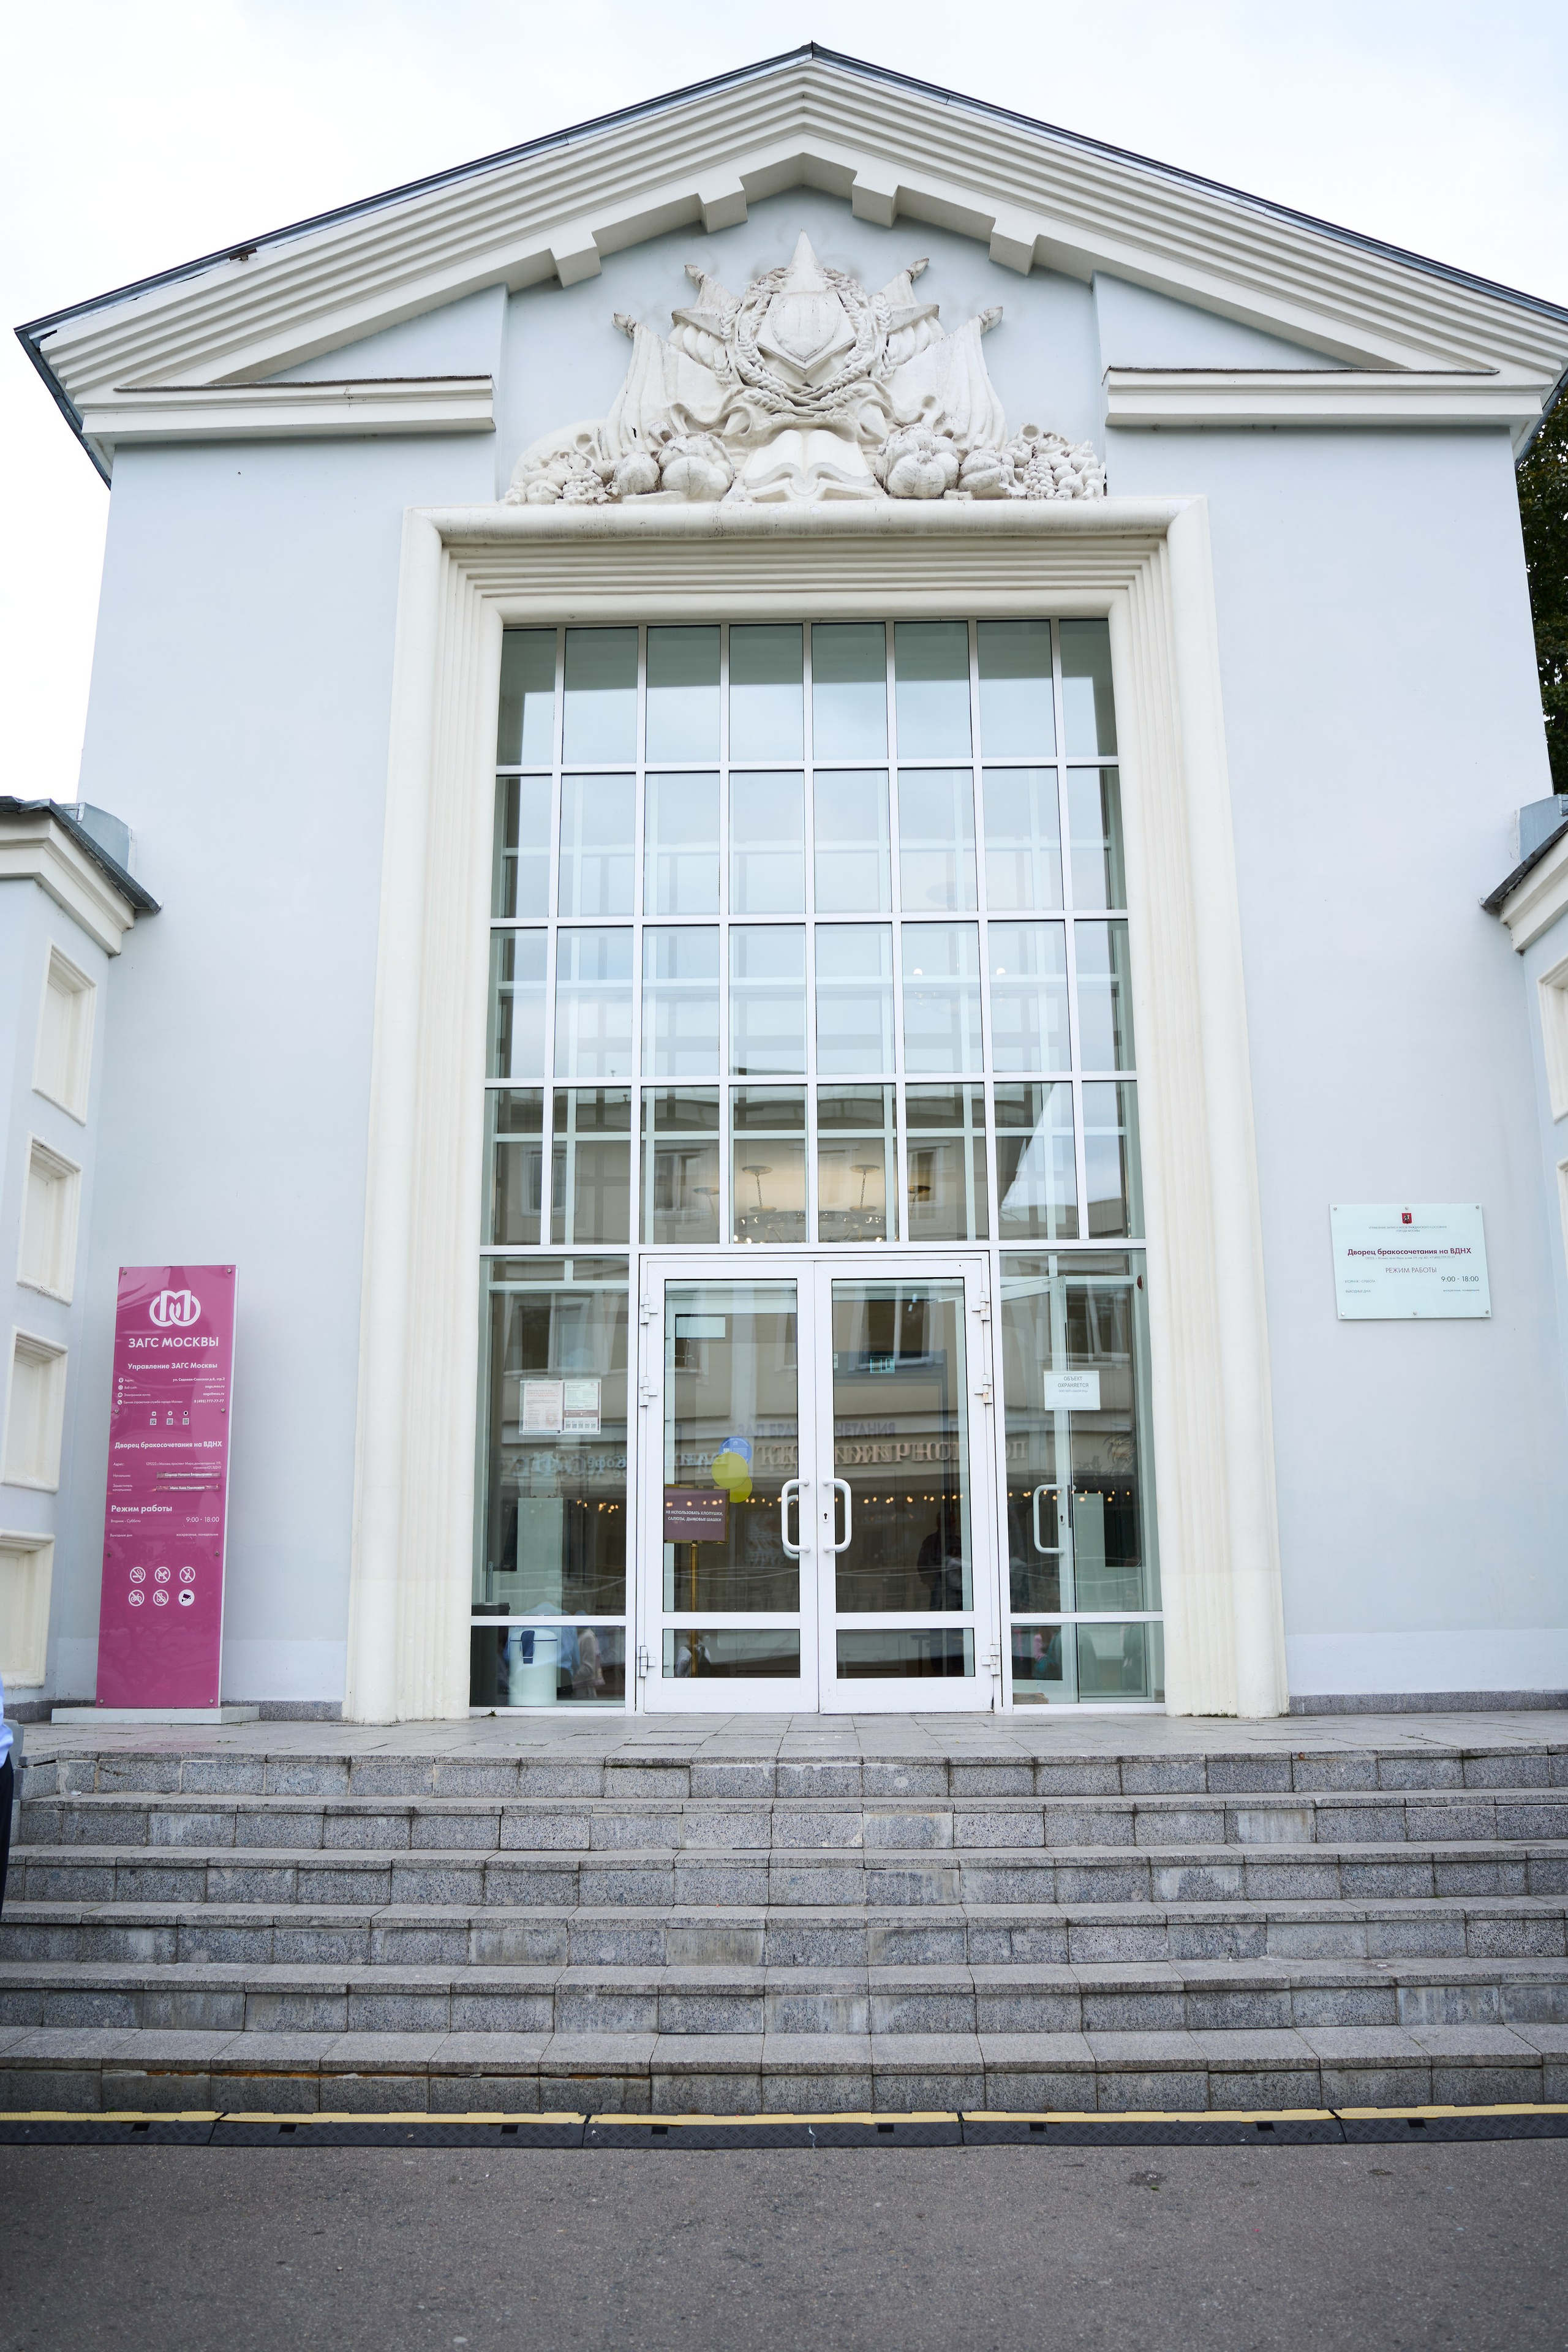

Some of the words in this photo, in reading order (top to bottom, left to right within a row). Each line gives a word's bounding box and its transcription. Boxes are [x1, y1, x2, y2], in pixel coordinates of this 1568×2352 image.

[1348, 1249, 1376, 1257] Дворец
[1378, 1248, 1438, 1256] бракосочетания
[128, 1337, 159, 1348] ЗАГС
[161, 1336, 219, 1348] МОСКВЫ
[127, 1363, 170, 1371] Управление
[141, 1504, 172, 1513] работы
